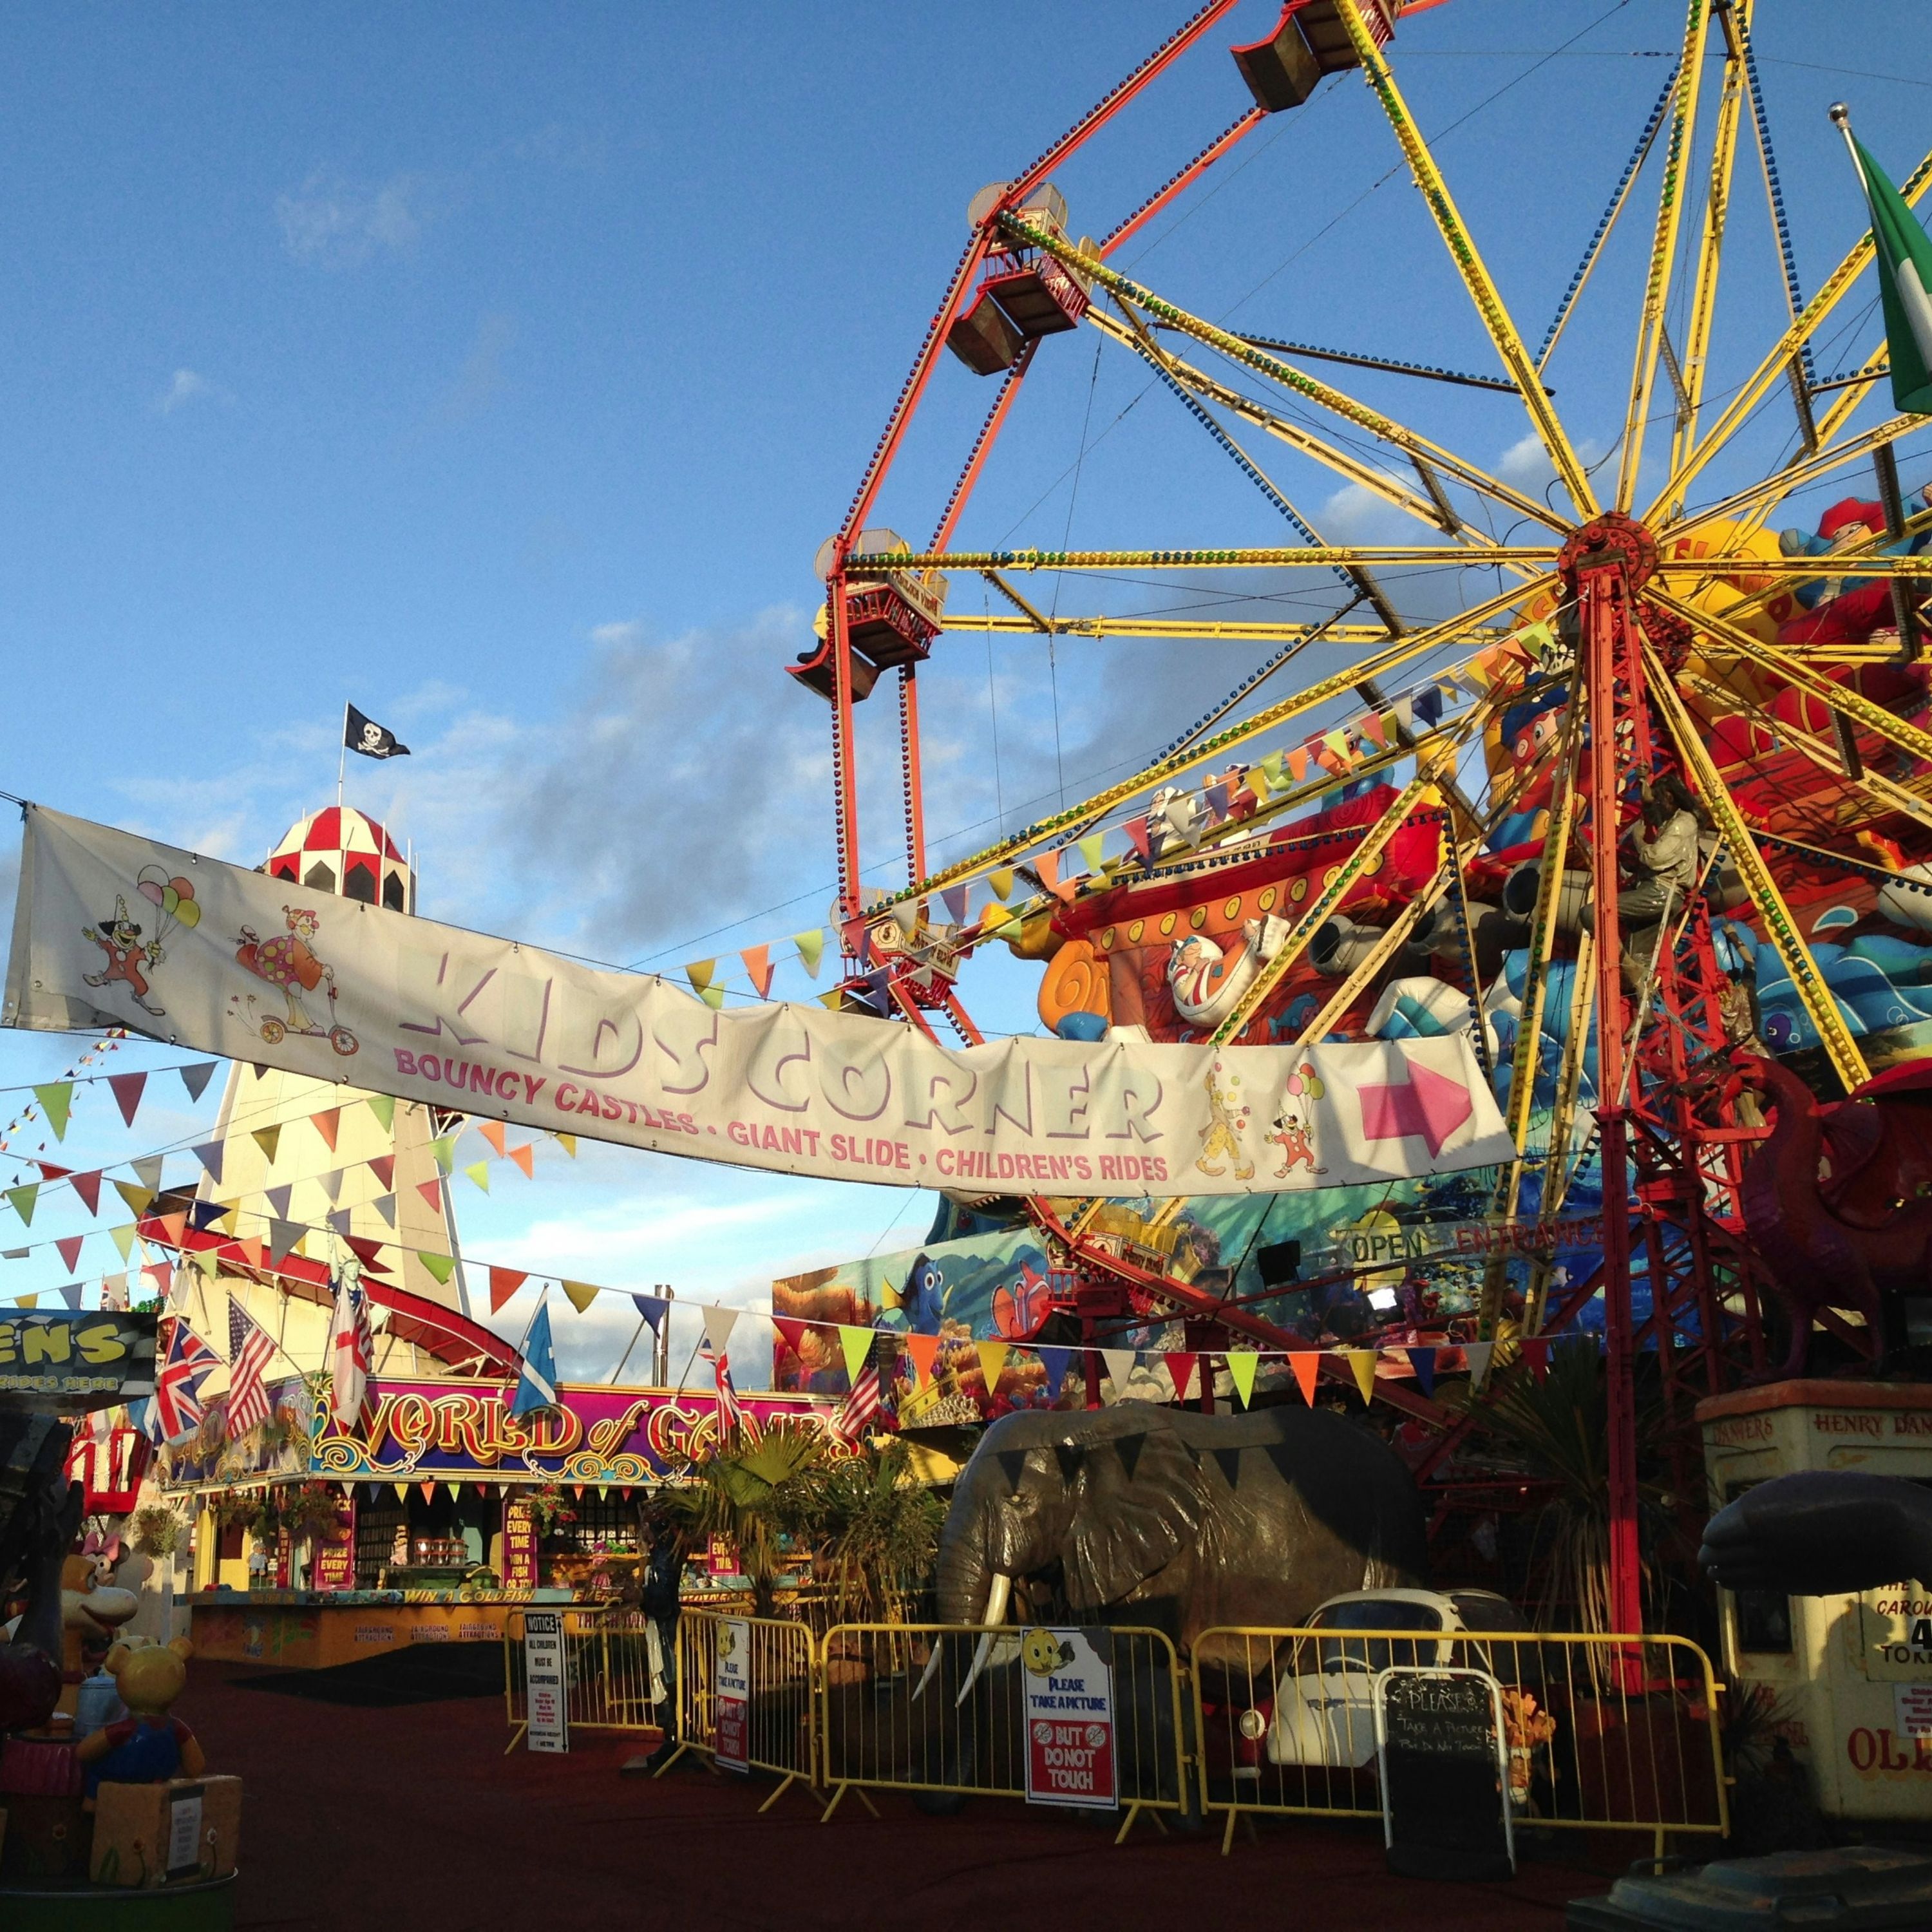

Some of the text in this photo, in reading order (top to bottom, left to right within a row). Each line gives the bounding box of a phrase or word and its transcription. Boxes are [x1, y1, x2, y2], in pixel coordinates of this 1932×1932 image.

[397, 949, 1164, 1144] KIDS CORNER
[393, 1048, 1168, 1180] BOUNCY CASTLES GIANT SLIDE CHILDREN'S RIDES
[1352, 1218, 1605, 1262] OPEN ENTRANCE
[63, 1377, 118, 1391] HERE
[326, 1390, 583, 1466] WORLD
[587, 1399, 650, 1460] of
[1814, 1414, 1882, 1441] HENRY
[506, 1520, 531, 1533] EVERY
[510, 1535, 529, 1549] TIME
[321, 1559, 348, 1570] EVERY
[509, 1553, 530, 1565] WIN A
[324, 1571, 345, 1582] TIME
[512, 1566, 528, 1578] FISH
[507, 1579, 517, 1589] OR
[404, 1590, 535, 1604] WIN A GOLDFISH
[527, 1615, 556, 1632] NOTICE
[1048, 1677, 1084, 1692] PLEASE
[1030, 1694, 1106, 1710] TAKE A PICTURE
[1410, 1691, 1462, 1712] PLEASE
[1055, 1726, 1083, 1746] BUT
[1044, 1747, 1096, 1768] DO NOT
[1048, 1769, 1094, 1790] TOUCH
